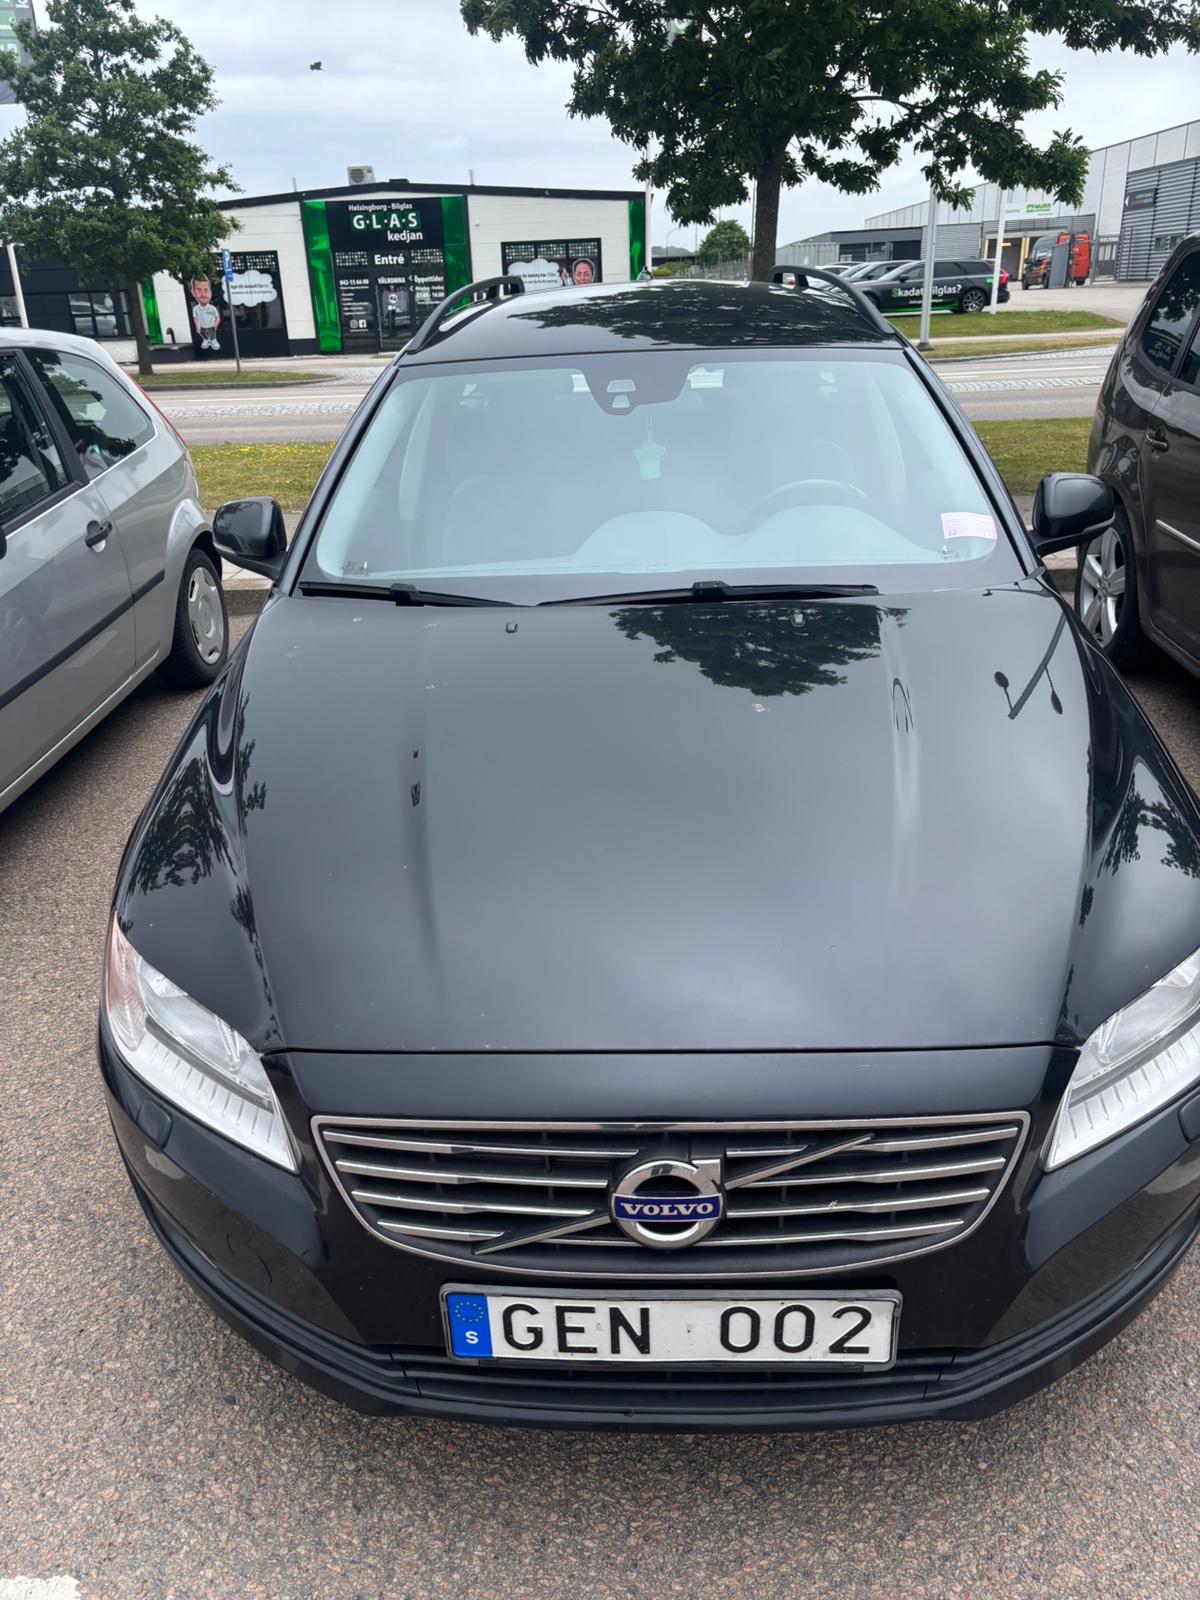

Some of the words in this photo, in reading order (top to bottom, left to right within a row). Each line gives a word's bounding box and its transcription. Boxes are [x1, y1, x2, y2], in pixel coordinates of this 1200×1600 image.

[348, 204, 387, 212] Helsingborg
[391, 202, 413, 211] Bilglas
[387, 230, 424, 243] kedjan
[374, 253, 405, 266] Entré
[414, 275, 444, 284] Öppettider
[931, 284, 962, 296] ilglas?
[620, 1202, 714, 1216] VOLVO
[501, 1303, 652, 1355] GEN
[719, 1304, 873, 1354] 002
[465, 1330, 479, 1344] S
